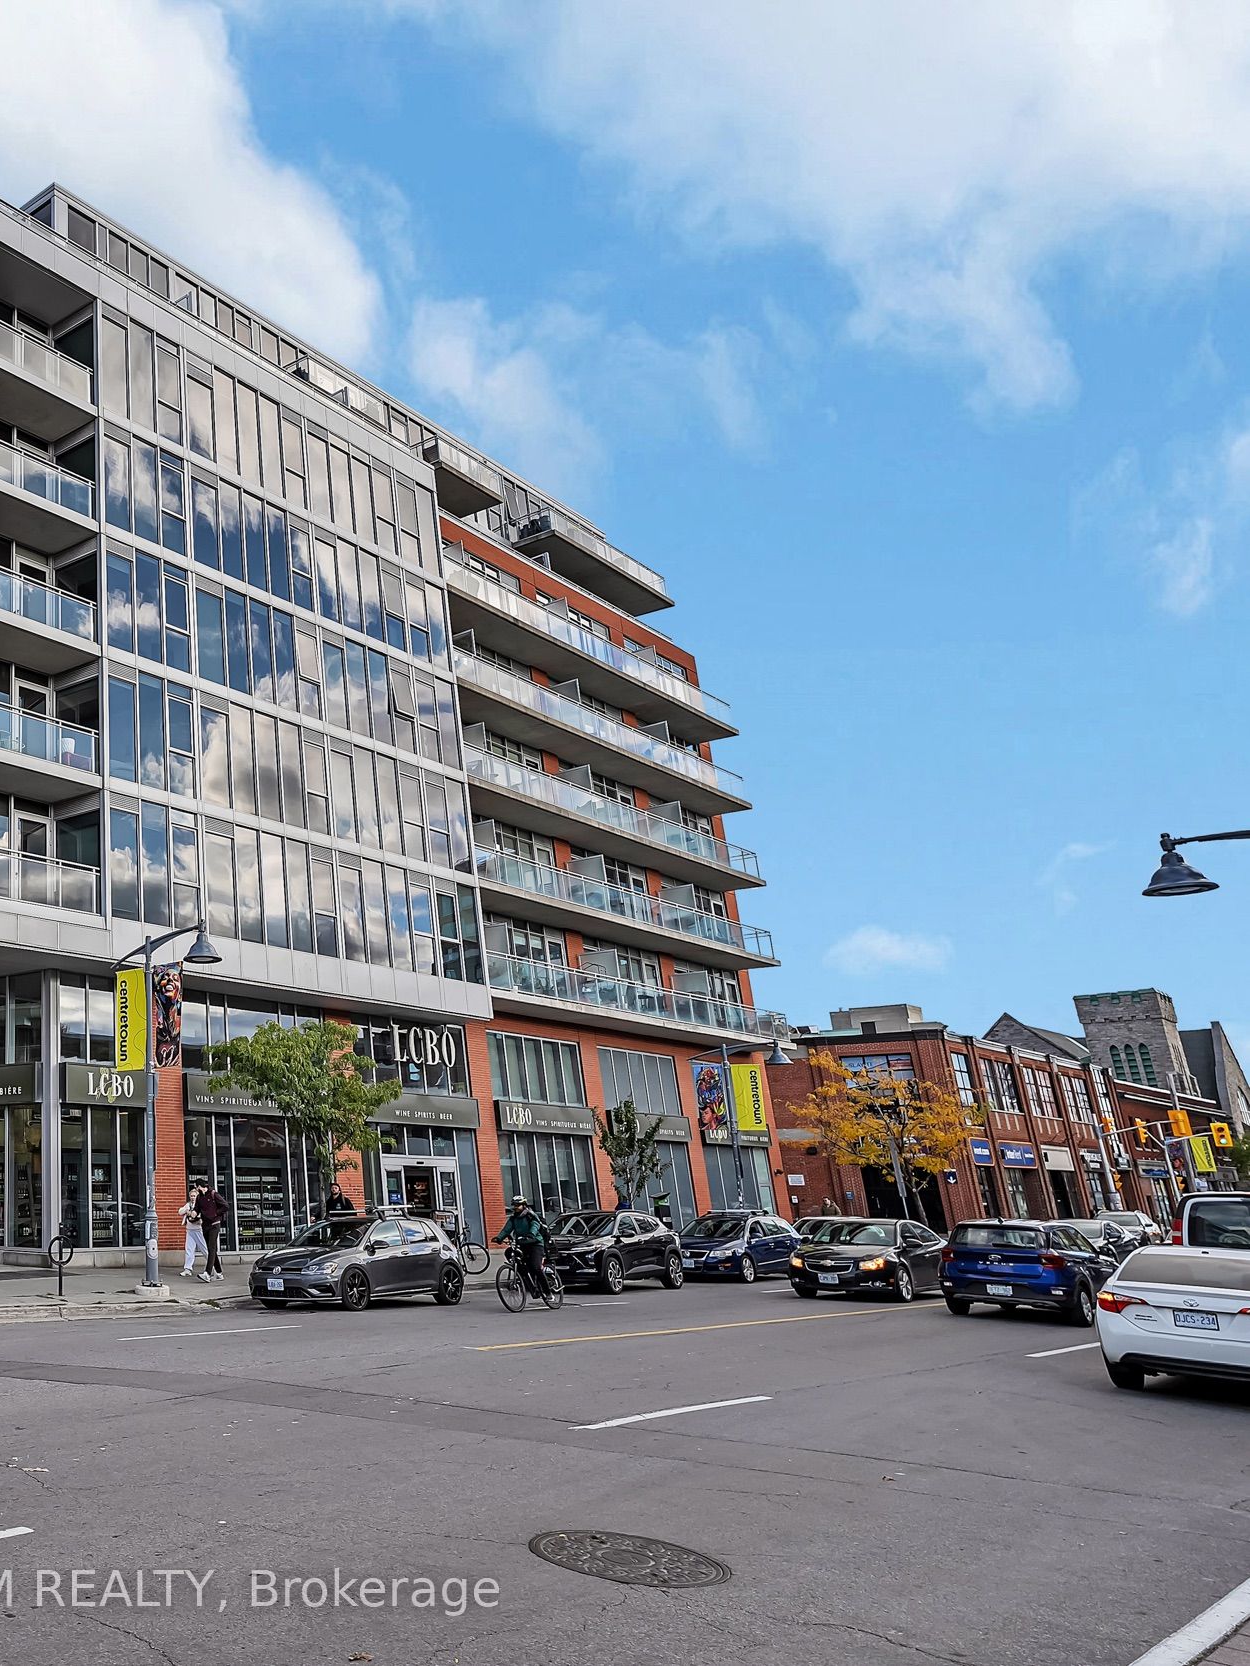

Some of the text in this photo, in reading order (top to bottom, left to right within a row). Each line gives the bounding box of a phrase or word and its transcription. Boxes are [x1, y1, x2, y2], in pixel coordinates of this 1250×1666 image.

[119, 979, 128, 1062] centretown
[394, 1025, 456, 1068] LCBO
[0, 1085, 22, 1096] BIÈRE
[87, 1072, 134, 1098] LCBO
[195, 1094, 214, 1104] VINS
[220, 1096, 263, 1107] SPIRITUEUX
[749, 1070, 763, 1125] centretown
[395, 1109, 453, 1120] WINE SPIRITS BEER
[505, 1106, 532, 1126] LCBO
[536, 1119, 548, 1127] VINS
